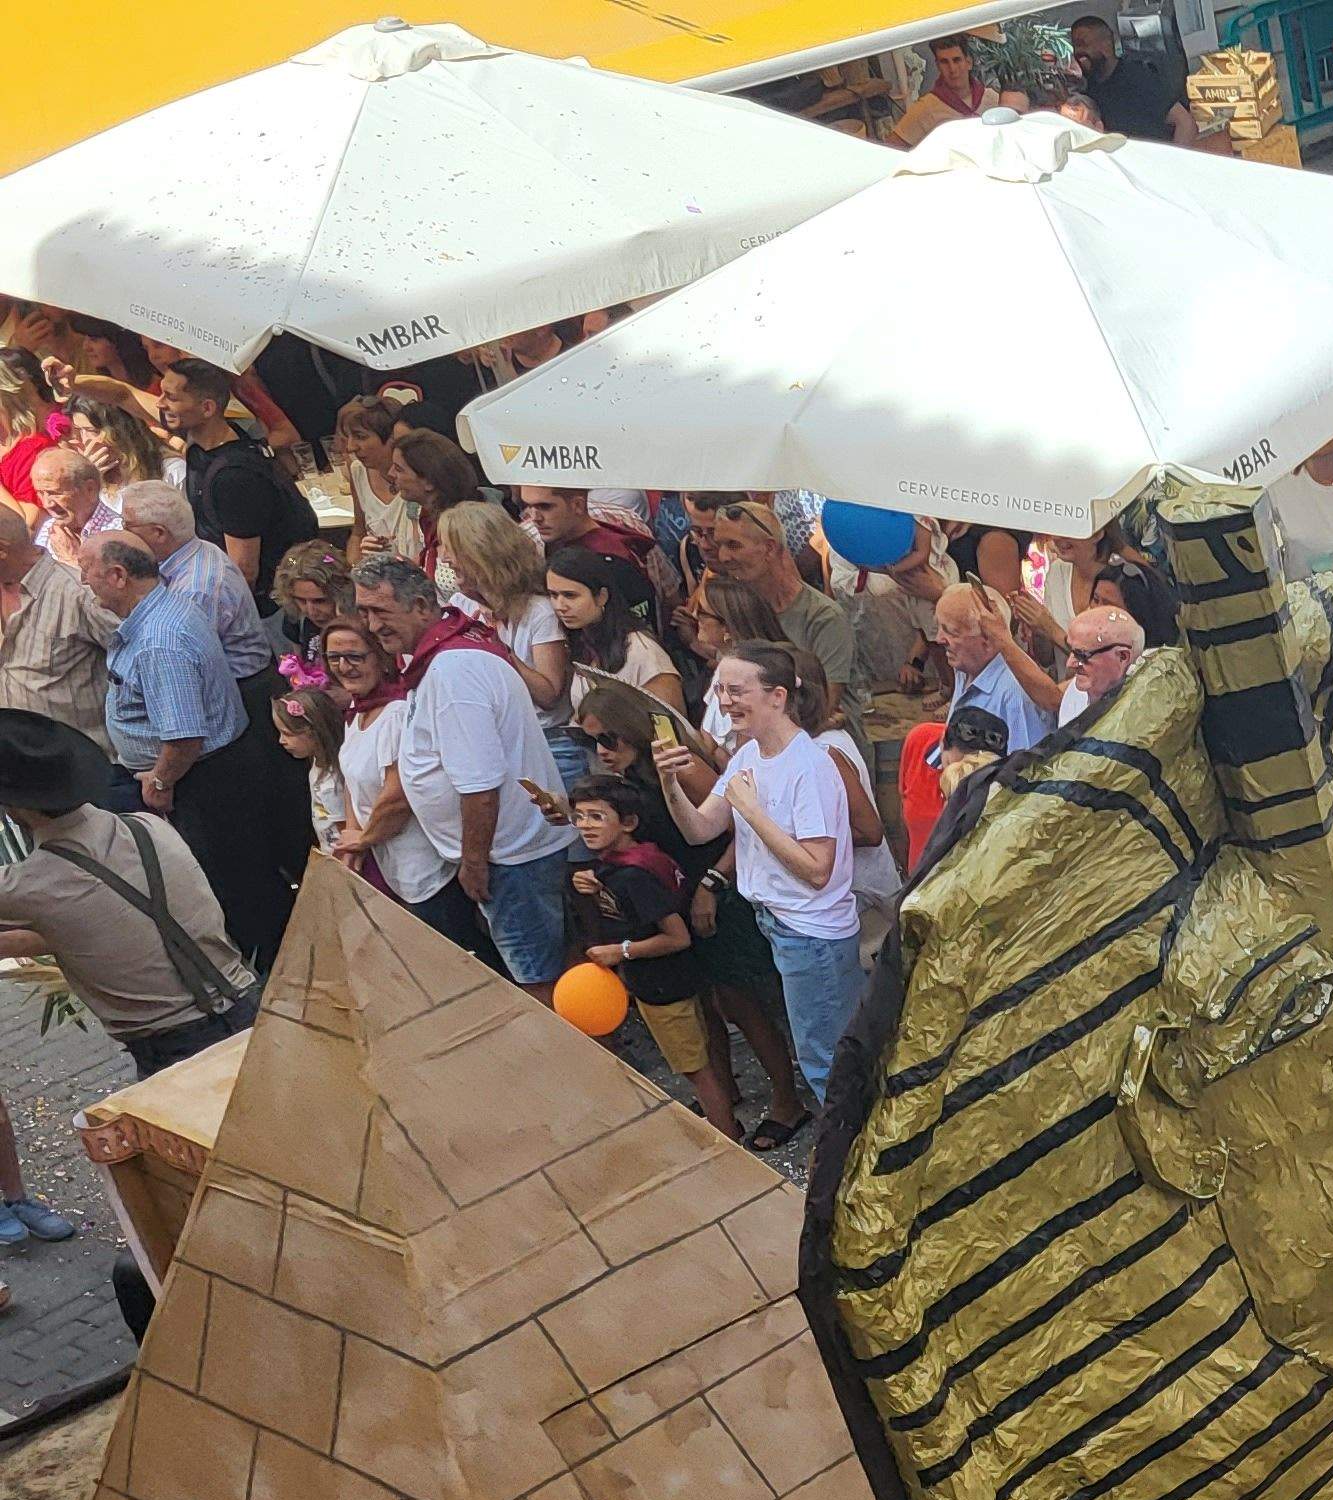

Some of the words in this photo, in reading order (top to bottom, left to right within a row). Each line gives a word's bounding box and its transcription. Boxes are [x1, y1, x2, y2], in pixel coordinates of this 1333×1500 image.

[129, 303, 185, 333] CERVECEROS
[188, 324, 240, 353] INDEPENDIE
[355, 314, 451, 356] AMBAR
[521, 445, 603, 470] AMBAR
[1222, 438, 1278, 484] MBAR
[898, 480, 1000, 507] CERVECEROS
[1006, 495, 1090, 520] INDEPENDI
